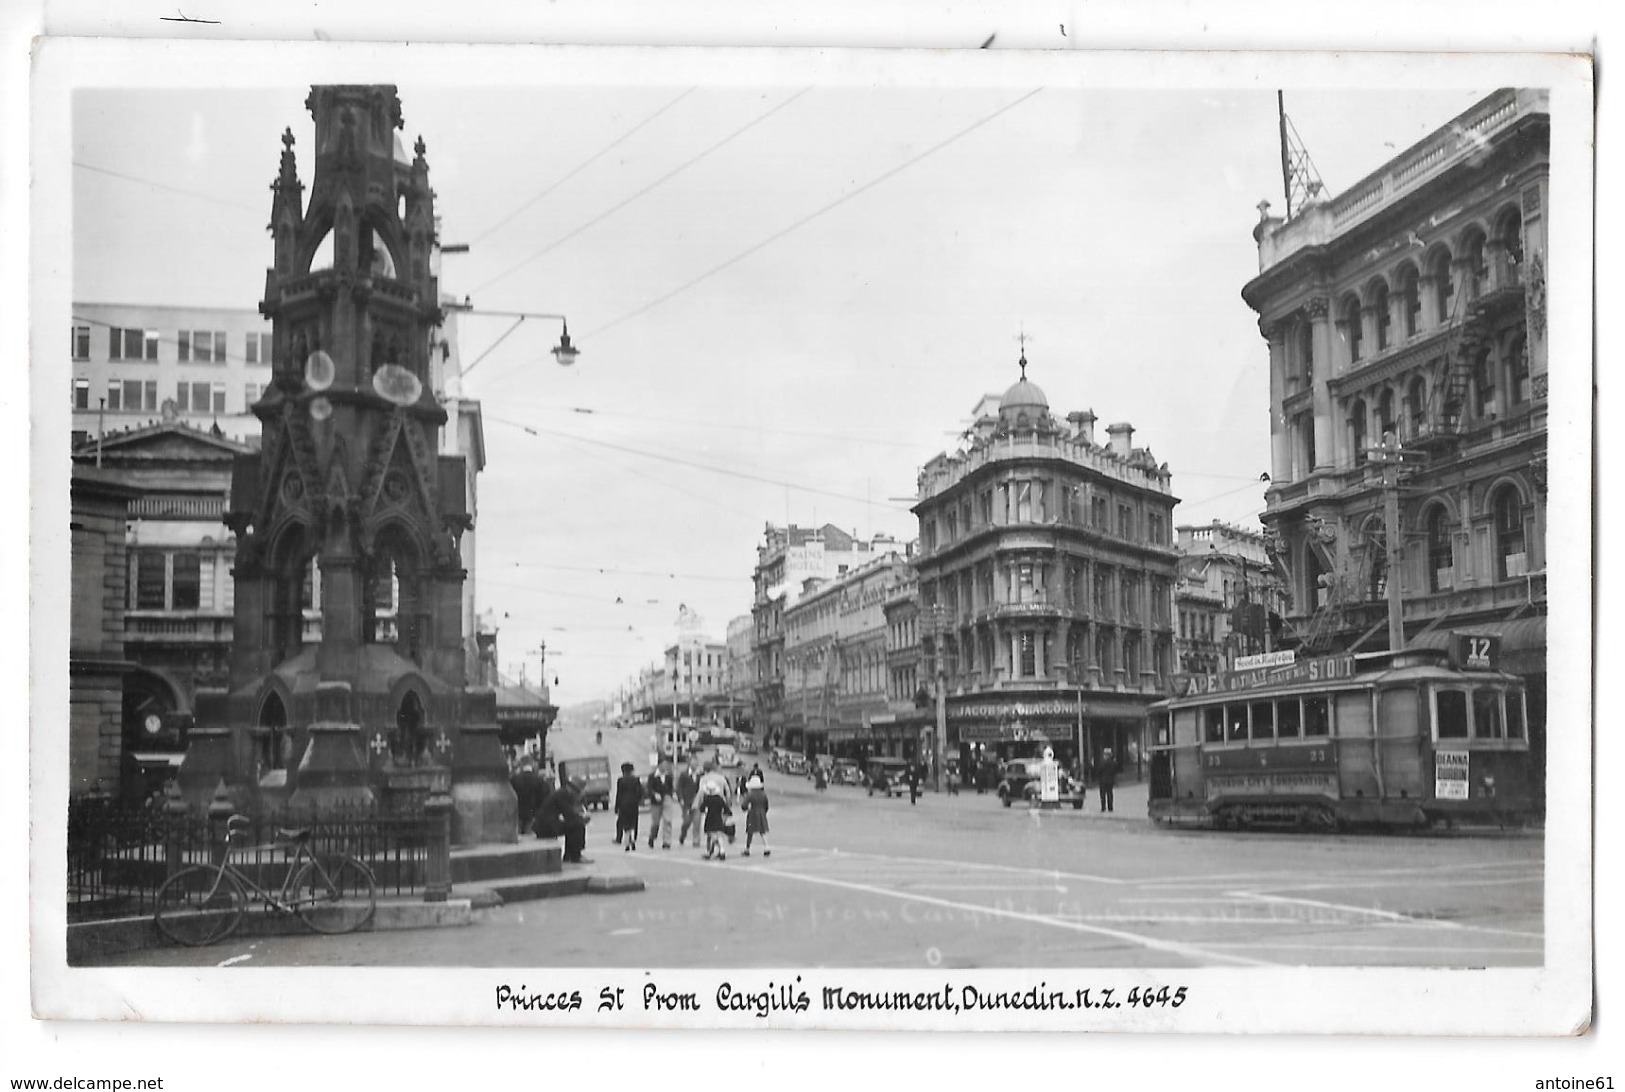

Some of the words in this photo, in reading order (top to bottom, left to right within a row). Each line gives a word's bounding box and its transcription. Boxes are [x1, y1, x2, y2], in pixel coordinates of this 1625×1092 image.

[789, 561, 824, 572] HOTEL
[1469, 638, 1491, 660] 12
[1187, 673, 1227, 696] APEX
[1309, 656, 1355, 682] STOUT
[1310, 749, 1325, 763] 23
[1437, 754, 1468, 766] DEANNA
